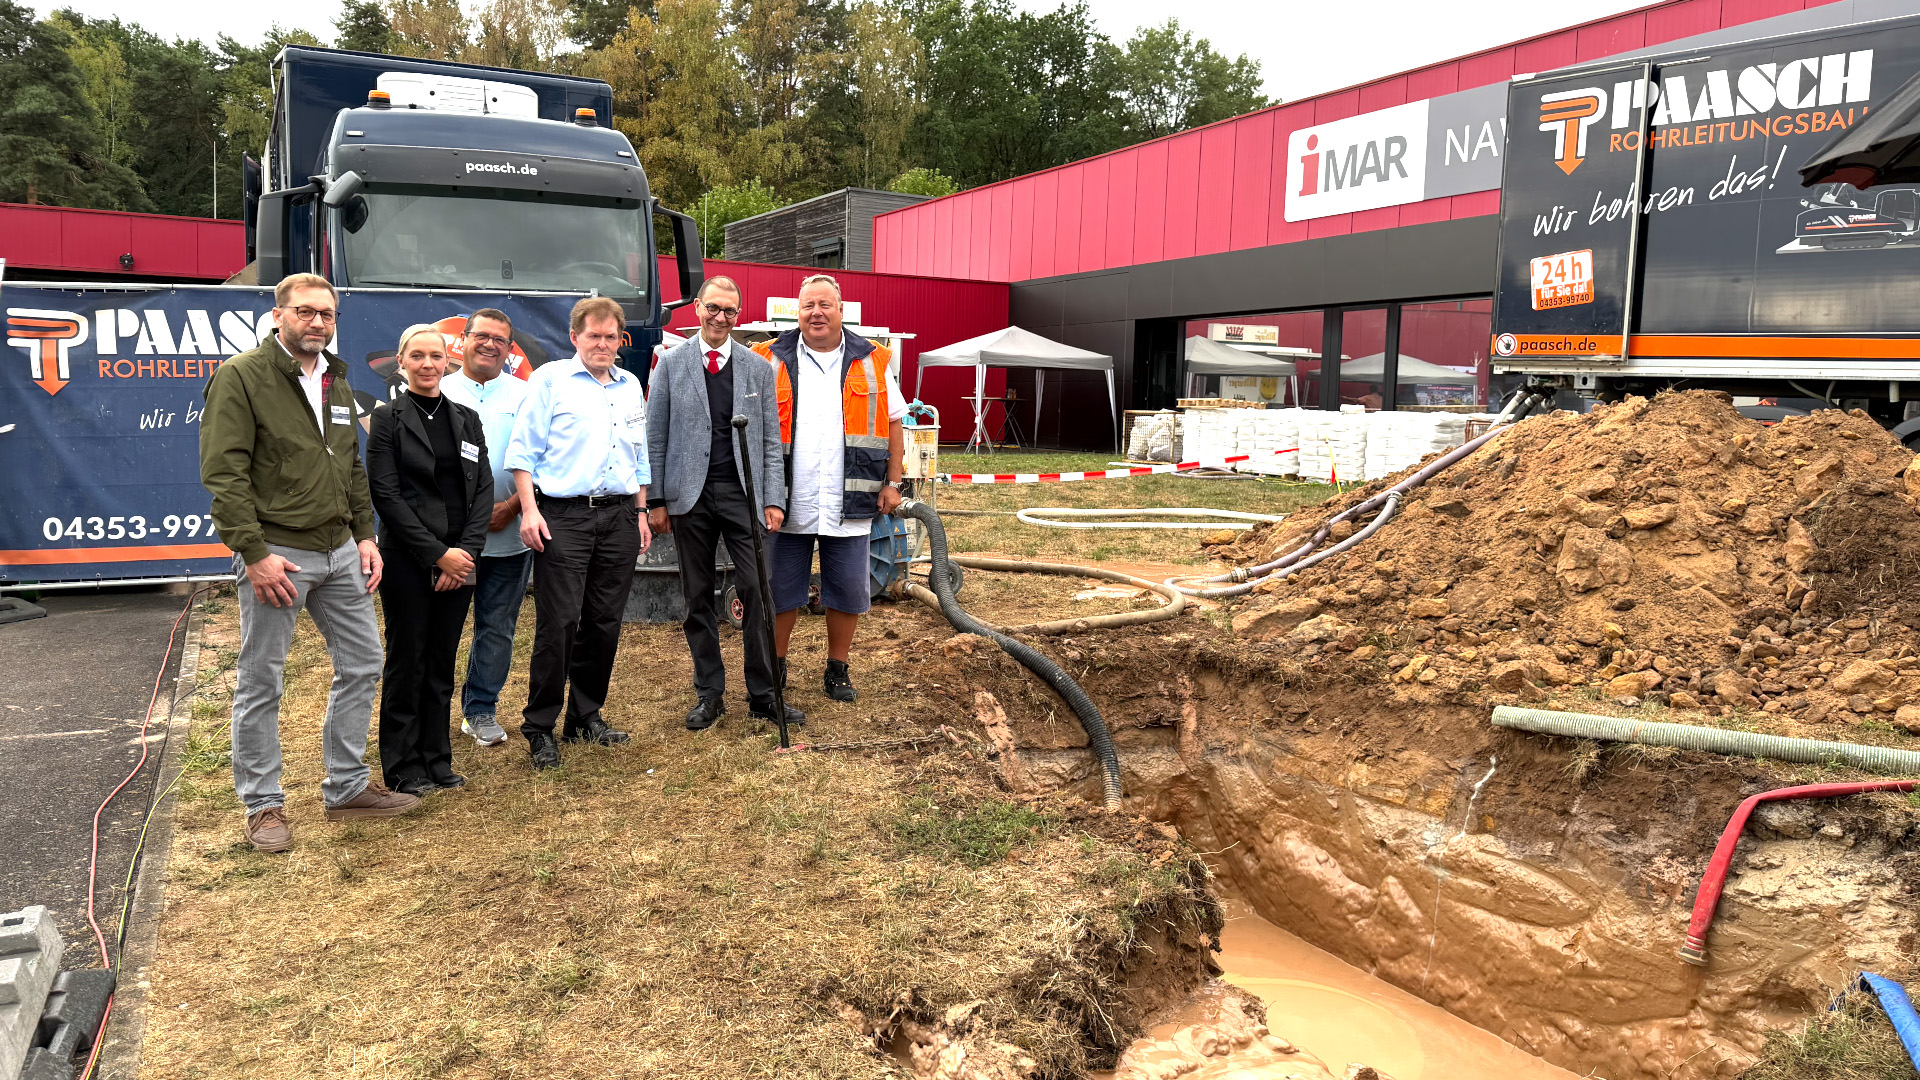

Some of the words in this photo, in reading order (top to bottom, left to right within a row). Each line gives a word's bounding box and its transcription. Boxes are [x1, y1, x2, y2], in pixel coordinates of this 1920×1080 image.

[1611, 49, 1874, 129] PAASCH
[465, 162, 538, 176] paasch.de
[1299, 134, 1408, 197] iMAR
[1533, 205, 1578, 237] Wir
[1588, 182, 1695, 226] bohren
[1708, 144, 1788, 201] das!
[1542, 259, 1567, 285] 24
[1571, 255, 1583, 281] h
[1541, 286, 1555, 299] für
[1556, 284, 1571, 297] Sie
[1573, 281, 1588, 294] da!
[1540, 294, 1590, 308] 04353-99740
[1519, 337, 1597, 353] paasch.de
[98, 359, 224, 379] ROHRLEIT
[140, 408, 176, 430] Wir
